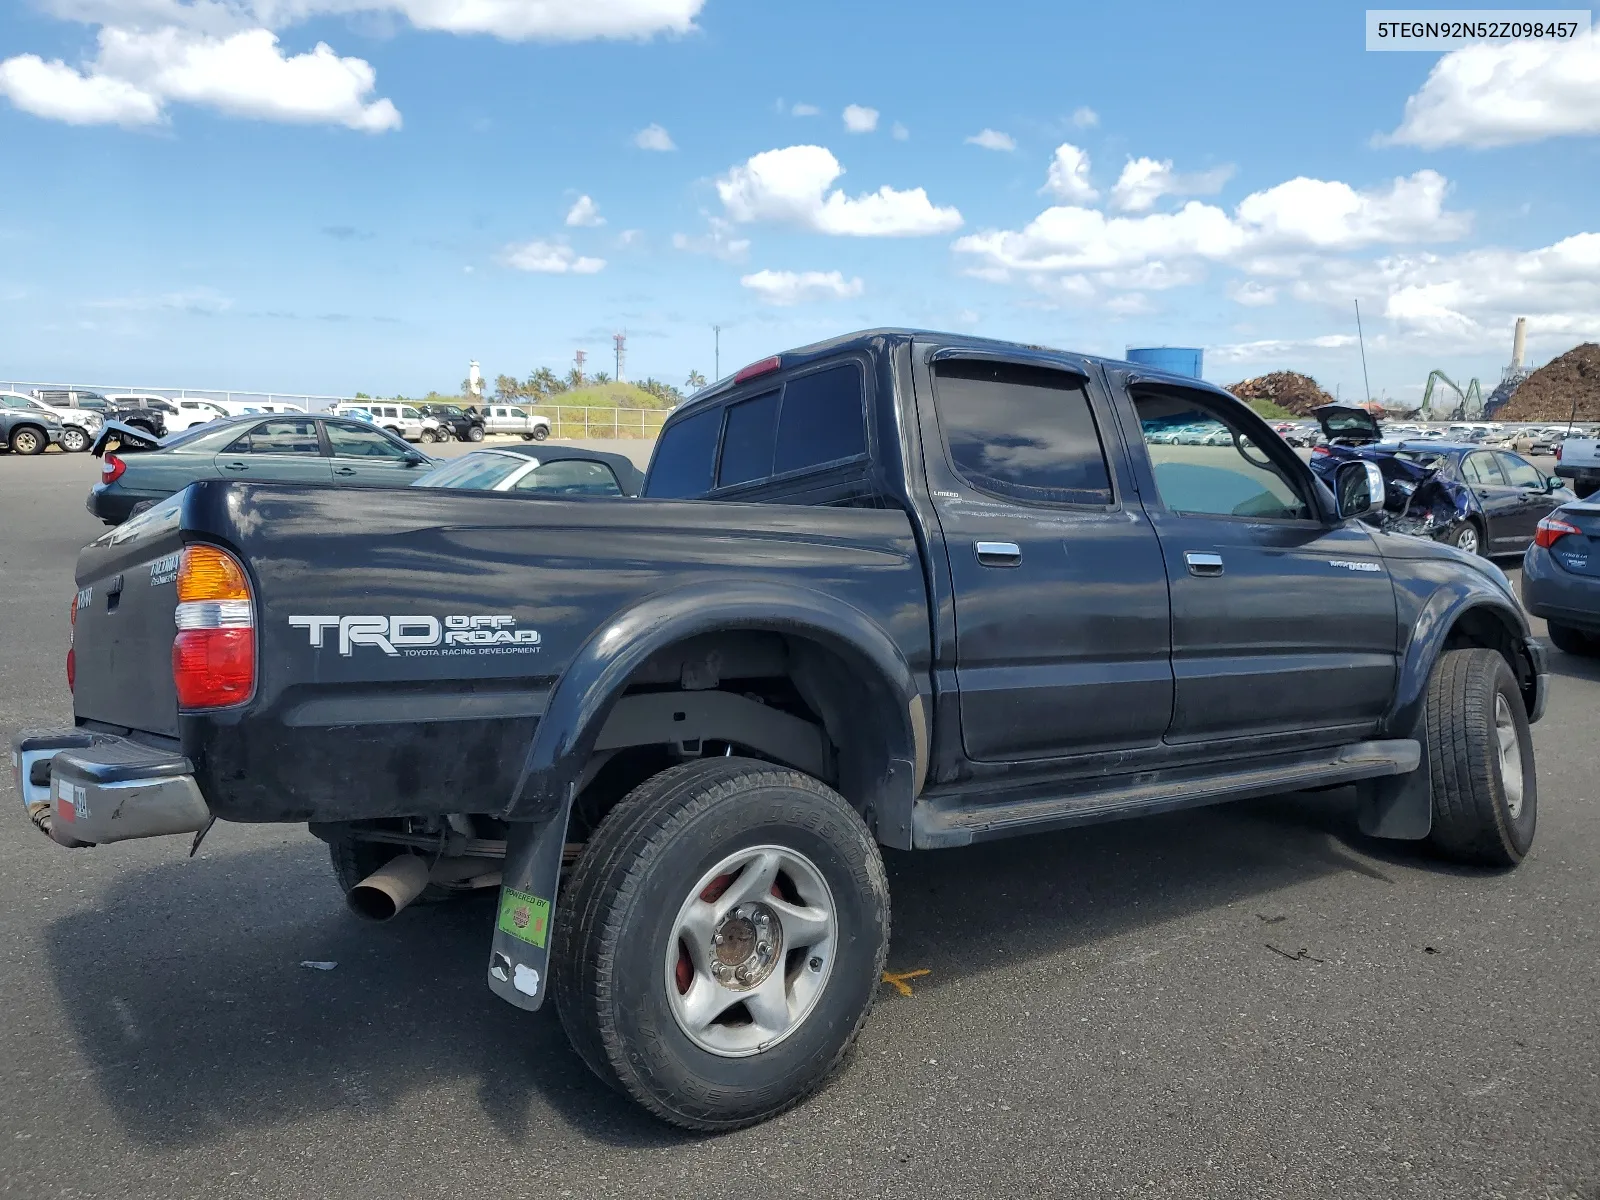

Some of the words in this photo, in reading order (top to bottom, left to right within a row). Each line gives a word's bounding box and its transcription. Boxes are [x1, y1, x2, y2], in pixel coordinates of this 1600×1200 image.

[288, 615, 443, 657] TRD
[445, 630, 541, 646] ROAD
[441, 648, 476, 656] RACING
[479, 646, 541, 655] DEVELOPMENT
[505, 887, 536, 904] POWERED
[536, 900, 547, 908] BY
